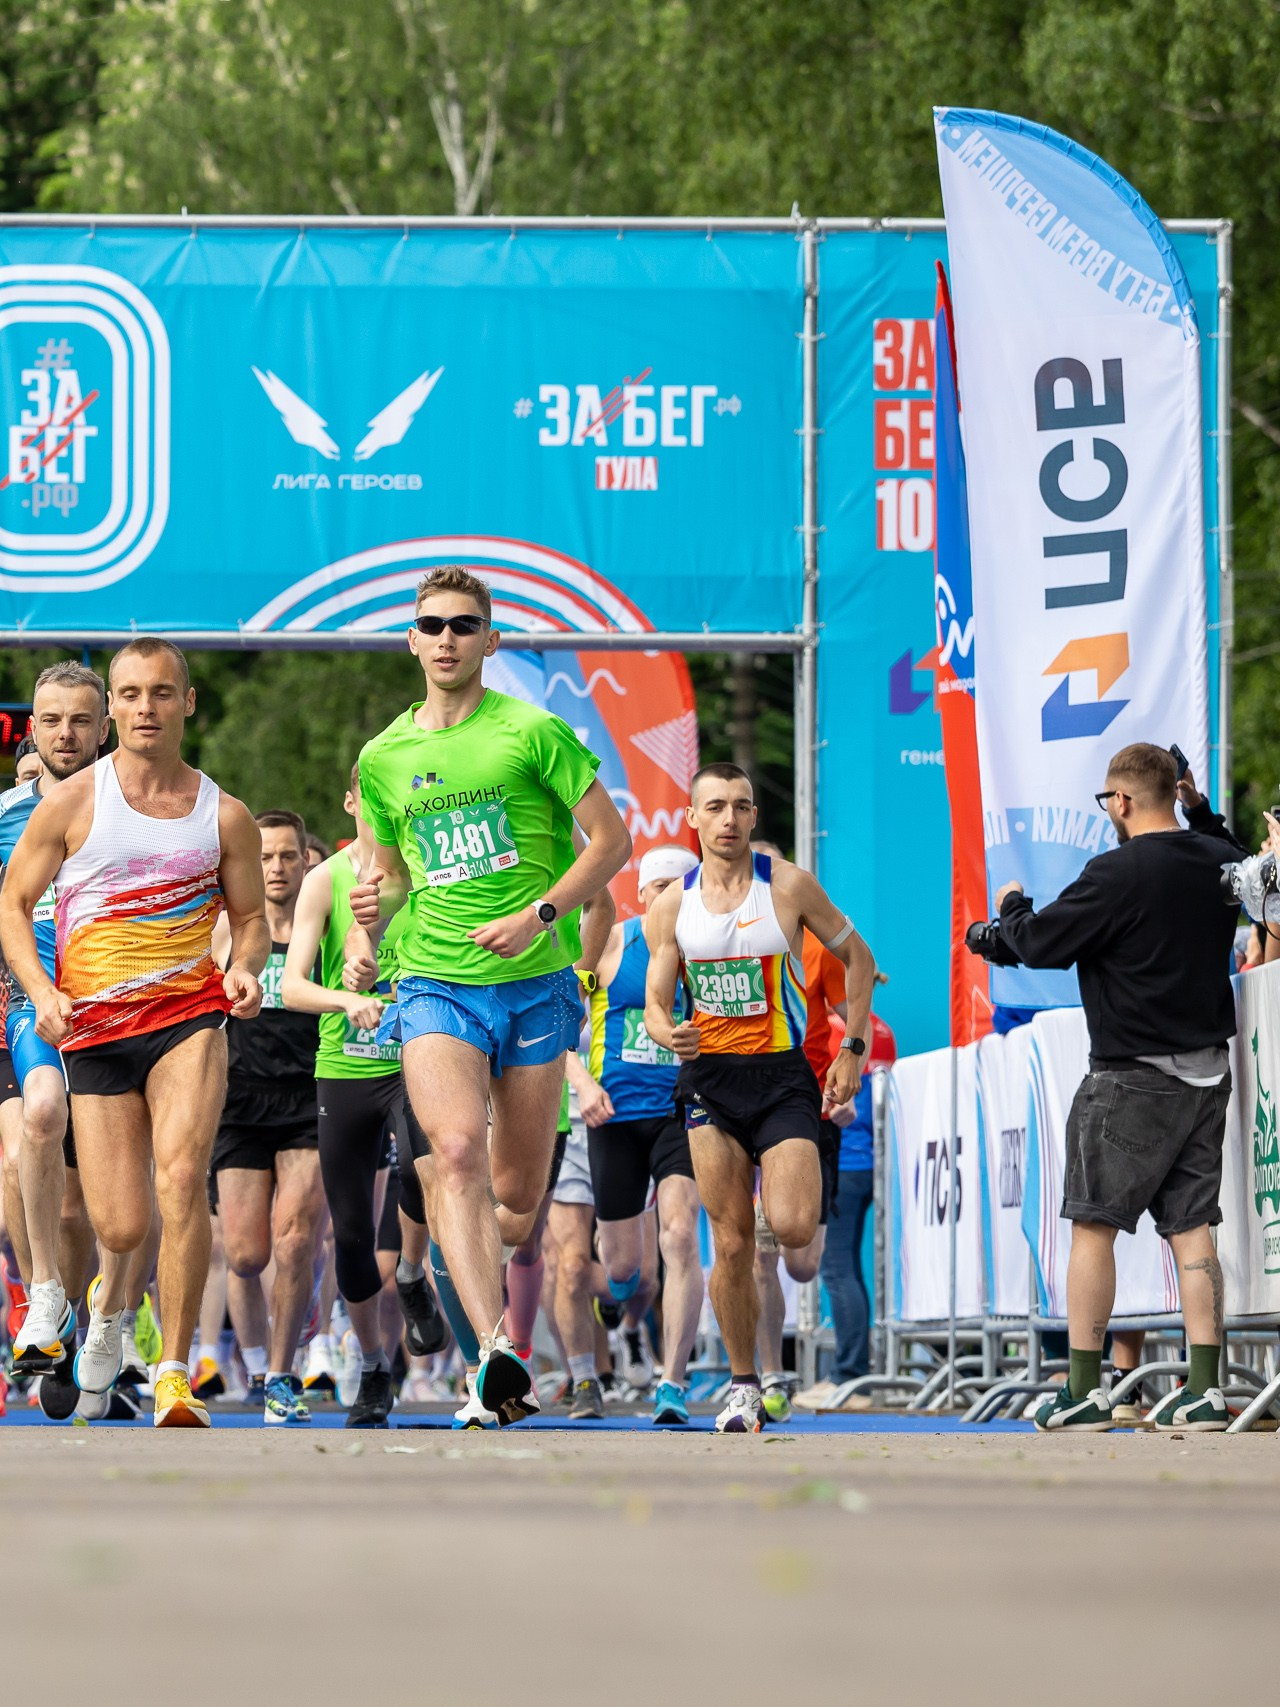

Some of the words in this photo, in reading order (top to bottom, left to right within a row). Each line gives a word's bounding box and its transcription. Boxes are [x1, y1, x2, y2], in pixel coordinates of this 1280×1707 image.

[9, 425, 98, 483] БЕГ
[875, 399, 934, 469] БЕ
[272, 473, 331, 490] ЛИГА
[338, 473, 423, 491] ГЕРОЕВ
[595, 456, 658, 491] ТУЛА
[876, 478, 933, 552] 10
[404, 784, 506, 818] К-ХОЛДИНГ
[434, 820, 496, 866] 2481
[697, 972, 751, 1003] 2399
